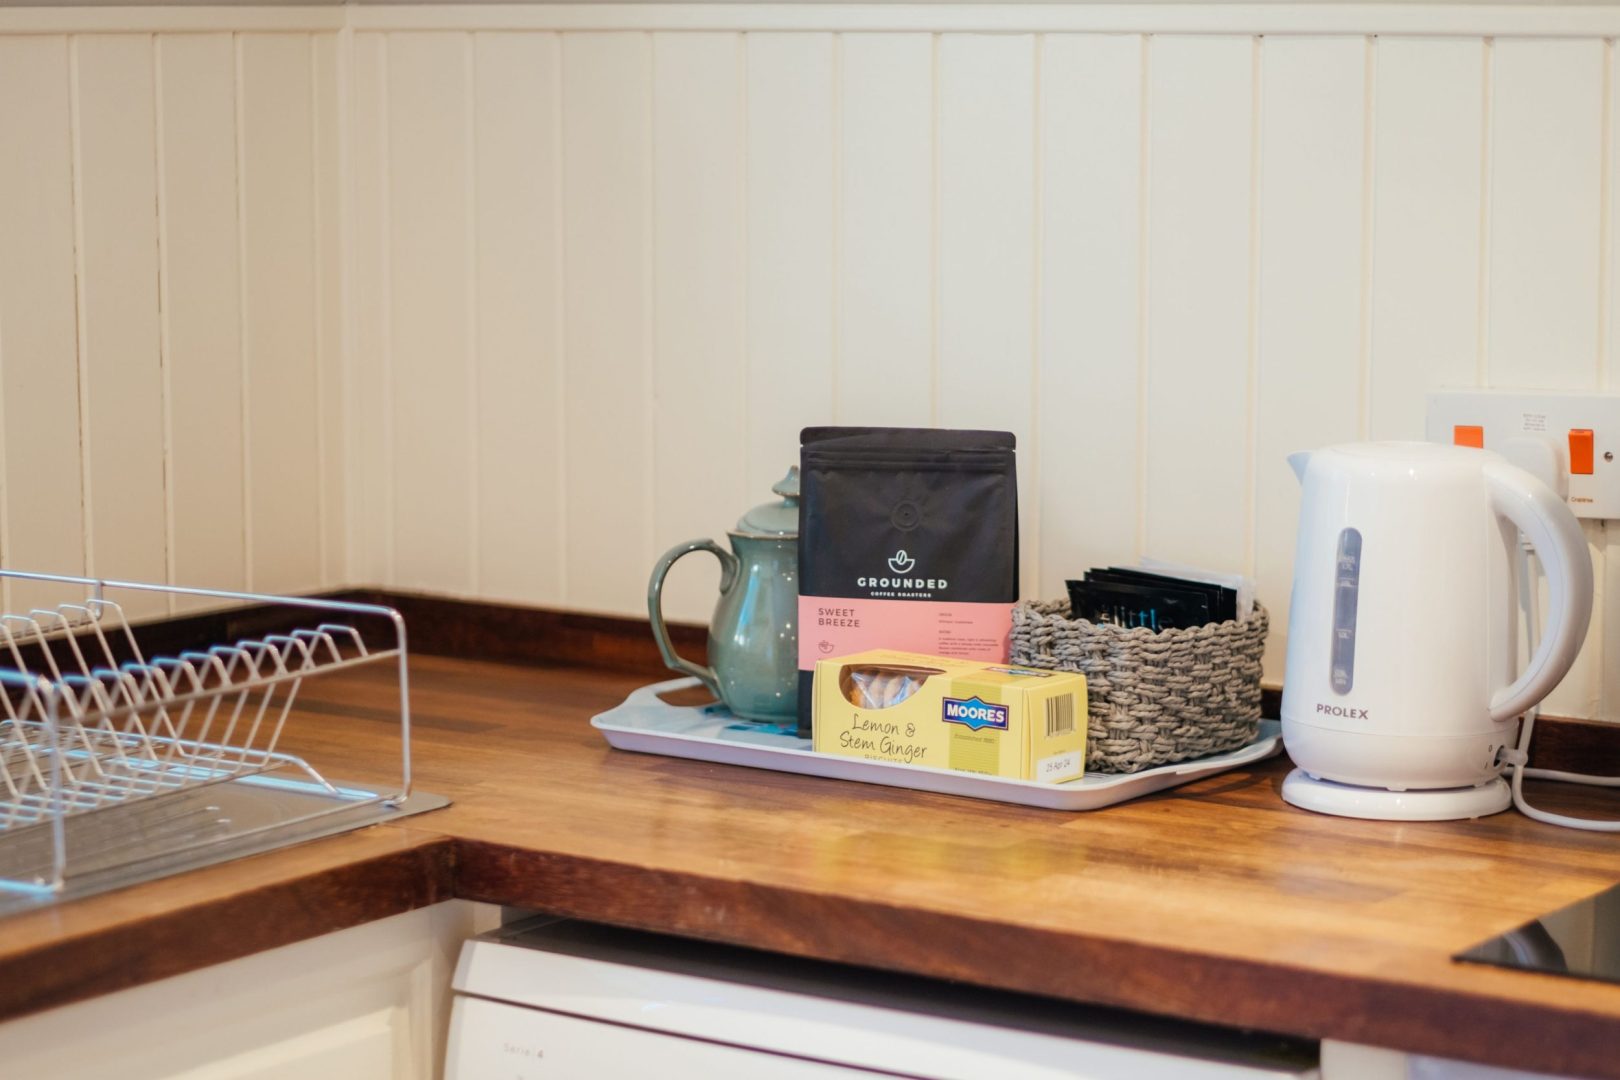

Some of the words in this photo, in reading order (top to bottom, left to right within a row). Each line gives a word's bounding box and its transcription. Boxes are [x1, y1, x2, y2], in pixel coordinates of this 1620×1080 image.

[857, 577, 948, 589] GROUNDED
[818, 607, 855, 617] SWEET
[818, 618, 860, 628] BREEZE
[947, 703, 1005, 723] MOORES
[1316, 703, 1369, 720] PROLEX
[852, 713, 900, 735] Lemon
[905, 722, 916, 738] &
[839, 730, 876, 751] Stem
[880, 736, 928, 764] Ginger
